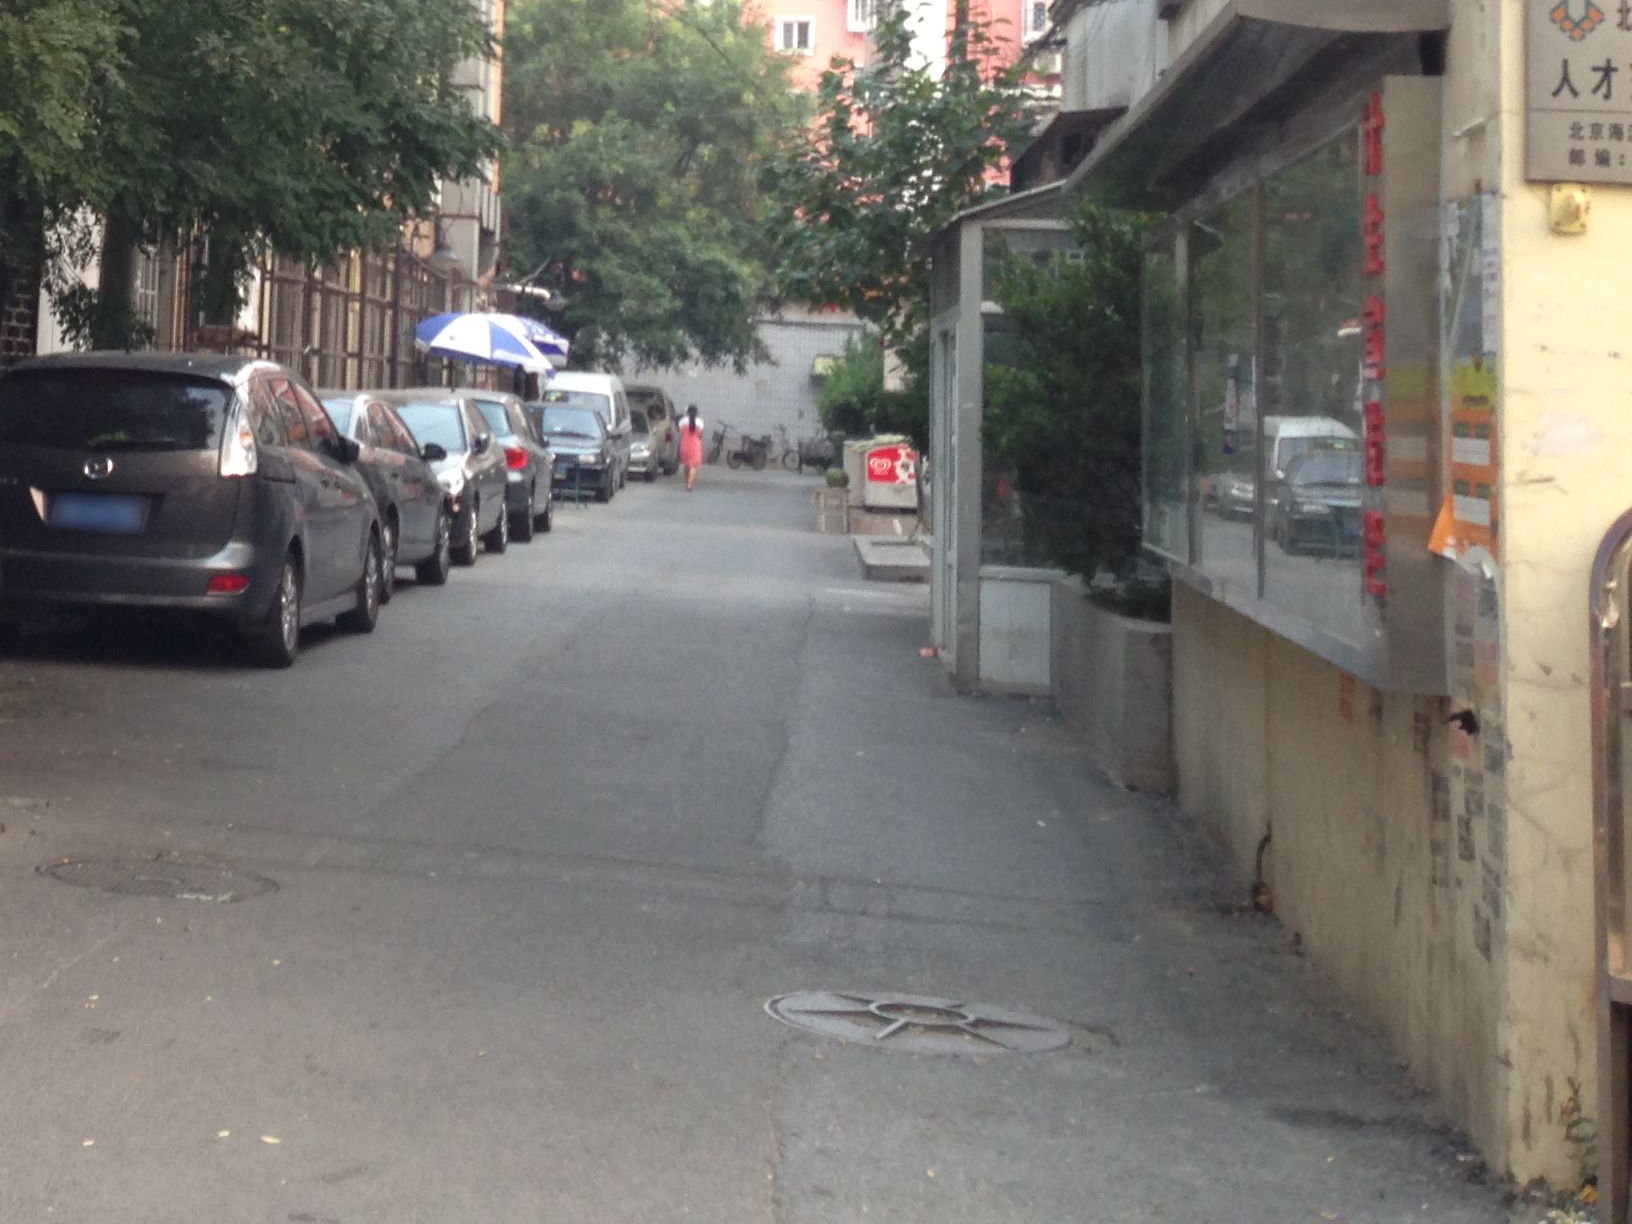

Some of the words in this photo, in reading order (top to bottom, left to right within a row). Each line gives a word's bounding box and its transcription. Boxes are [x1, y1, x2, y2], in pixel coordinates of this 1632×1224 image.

[1551, 58, 1632, 100] 人才
[1569, 121, 1632, 142] 北京海
